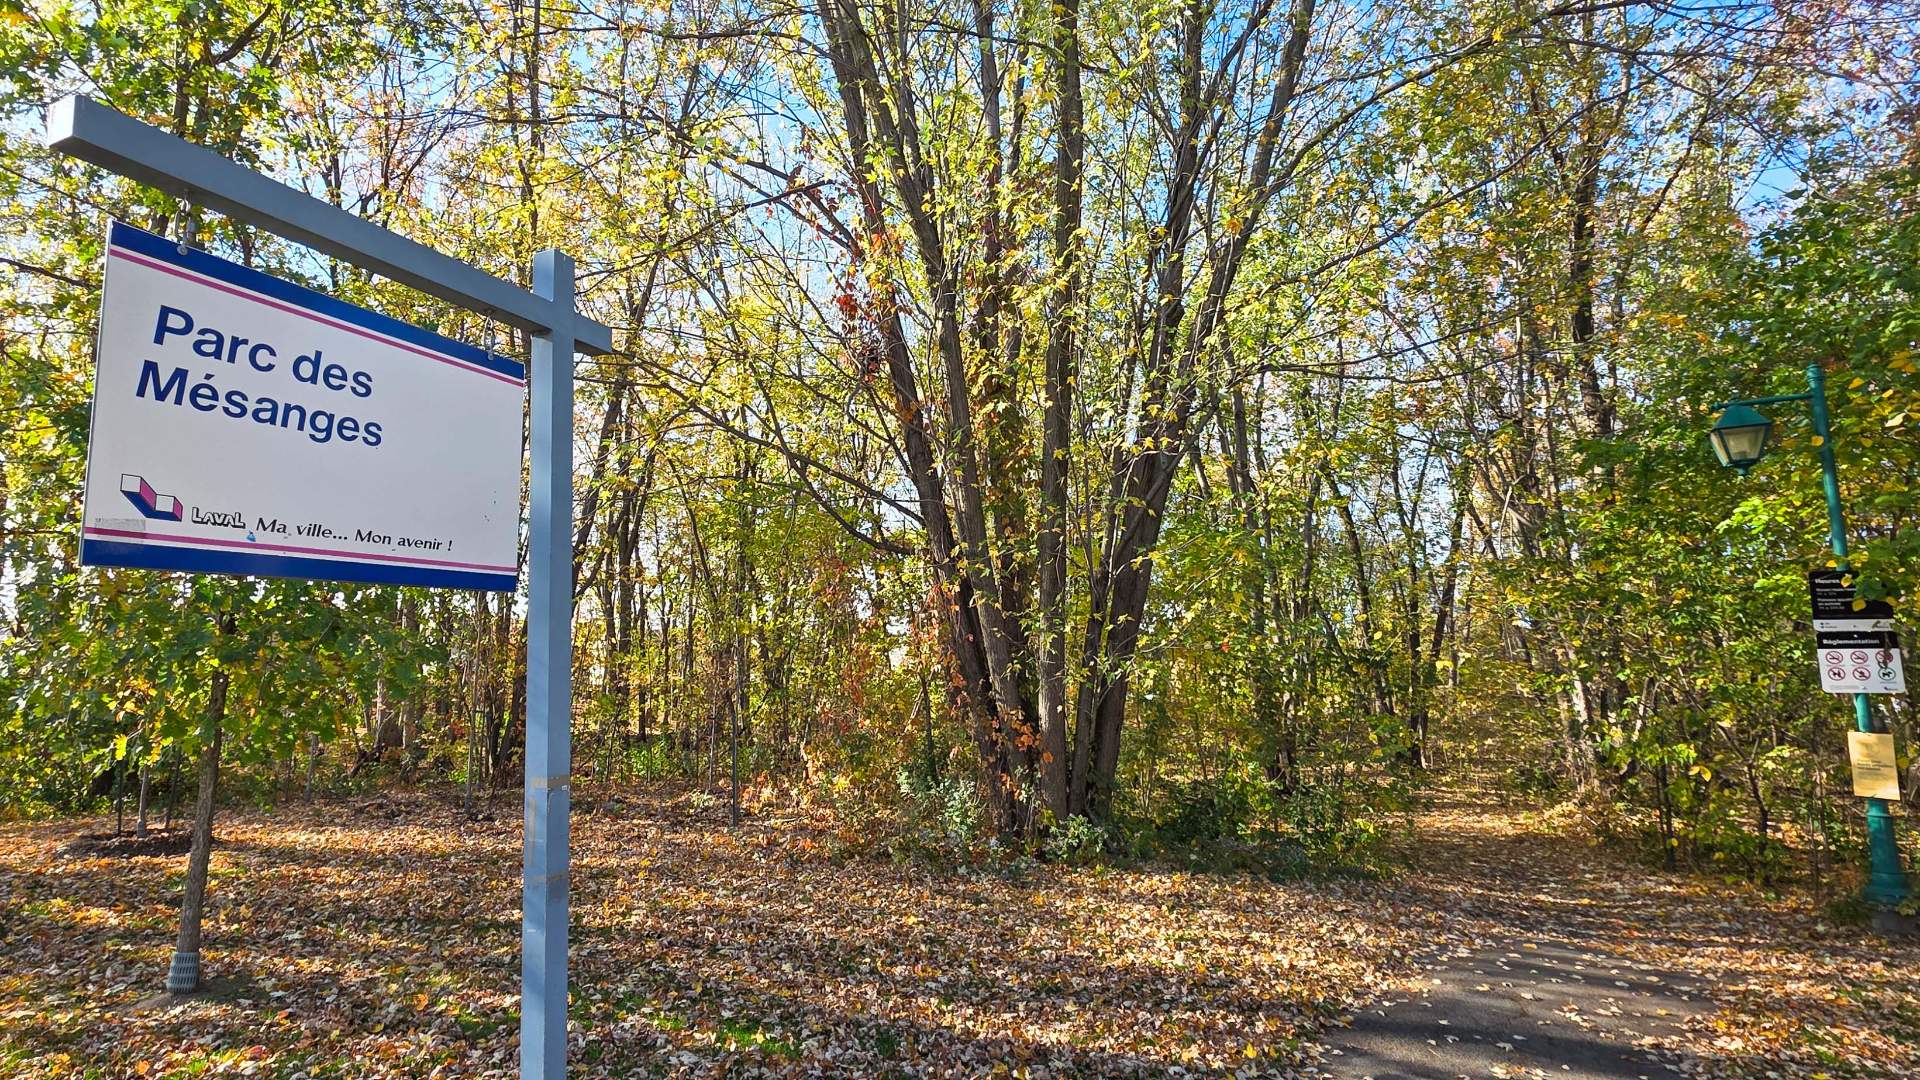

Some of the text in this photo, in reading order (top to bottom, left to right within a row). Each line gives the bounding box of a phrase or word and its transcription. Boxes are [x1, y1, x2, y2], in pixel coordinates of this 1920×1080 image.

[153, 304, 373, 398] Parc des
[136, 359, 383, 447] Mésanges
[255, 516, 287, 534] Ma
[296, 522, 349, 541] ville...
[354, 528, 392, 546] Mon
[397, 535, 443, 551] avenir
